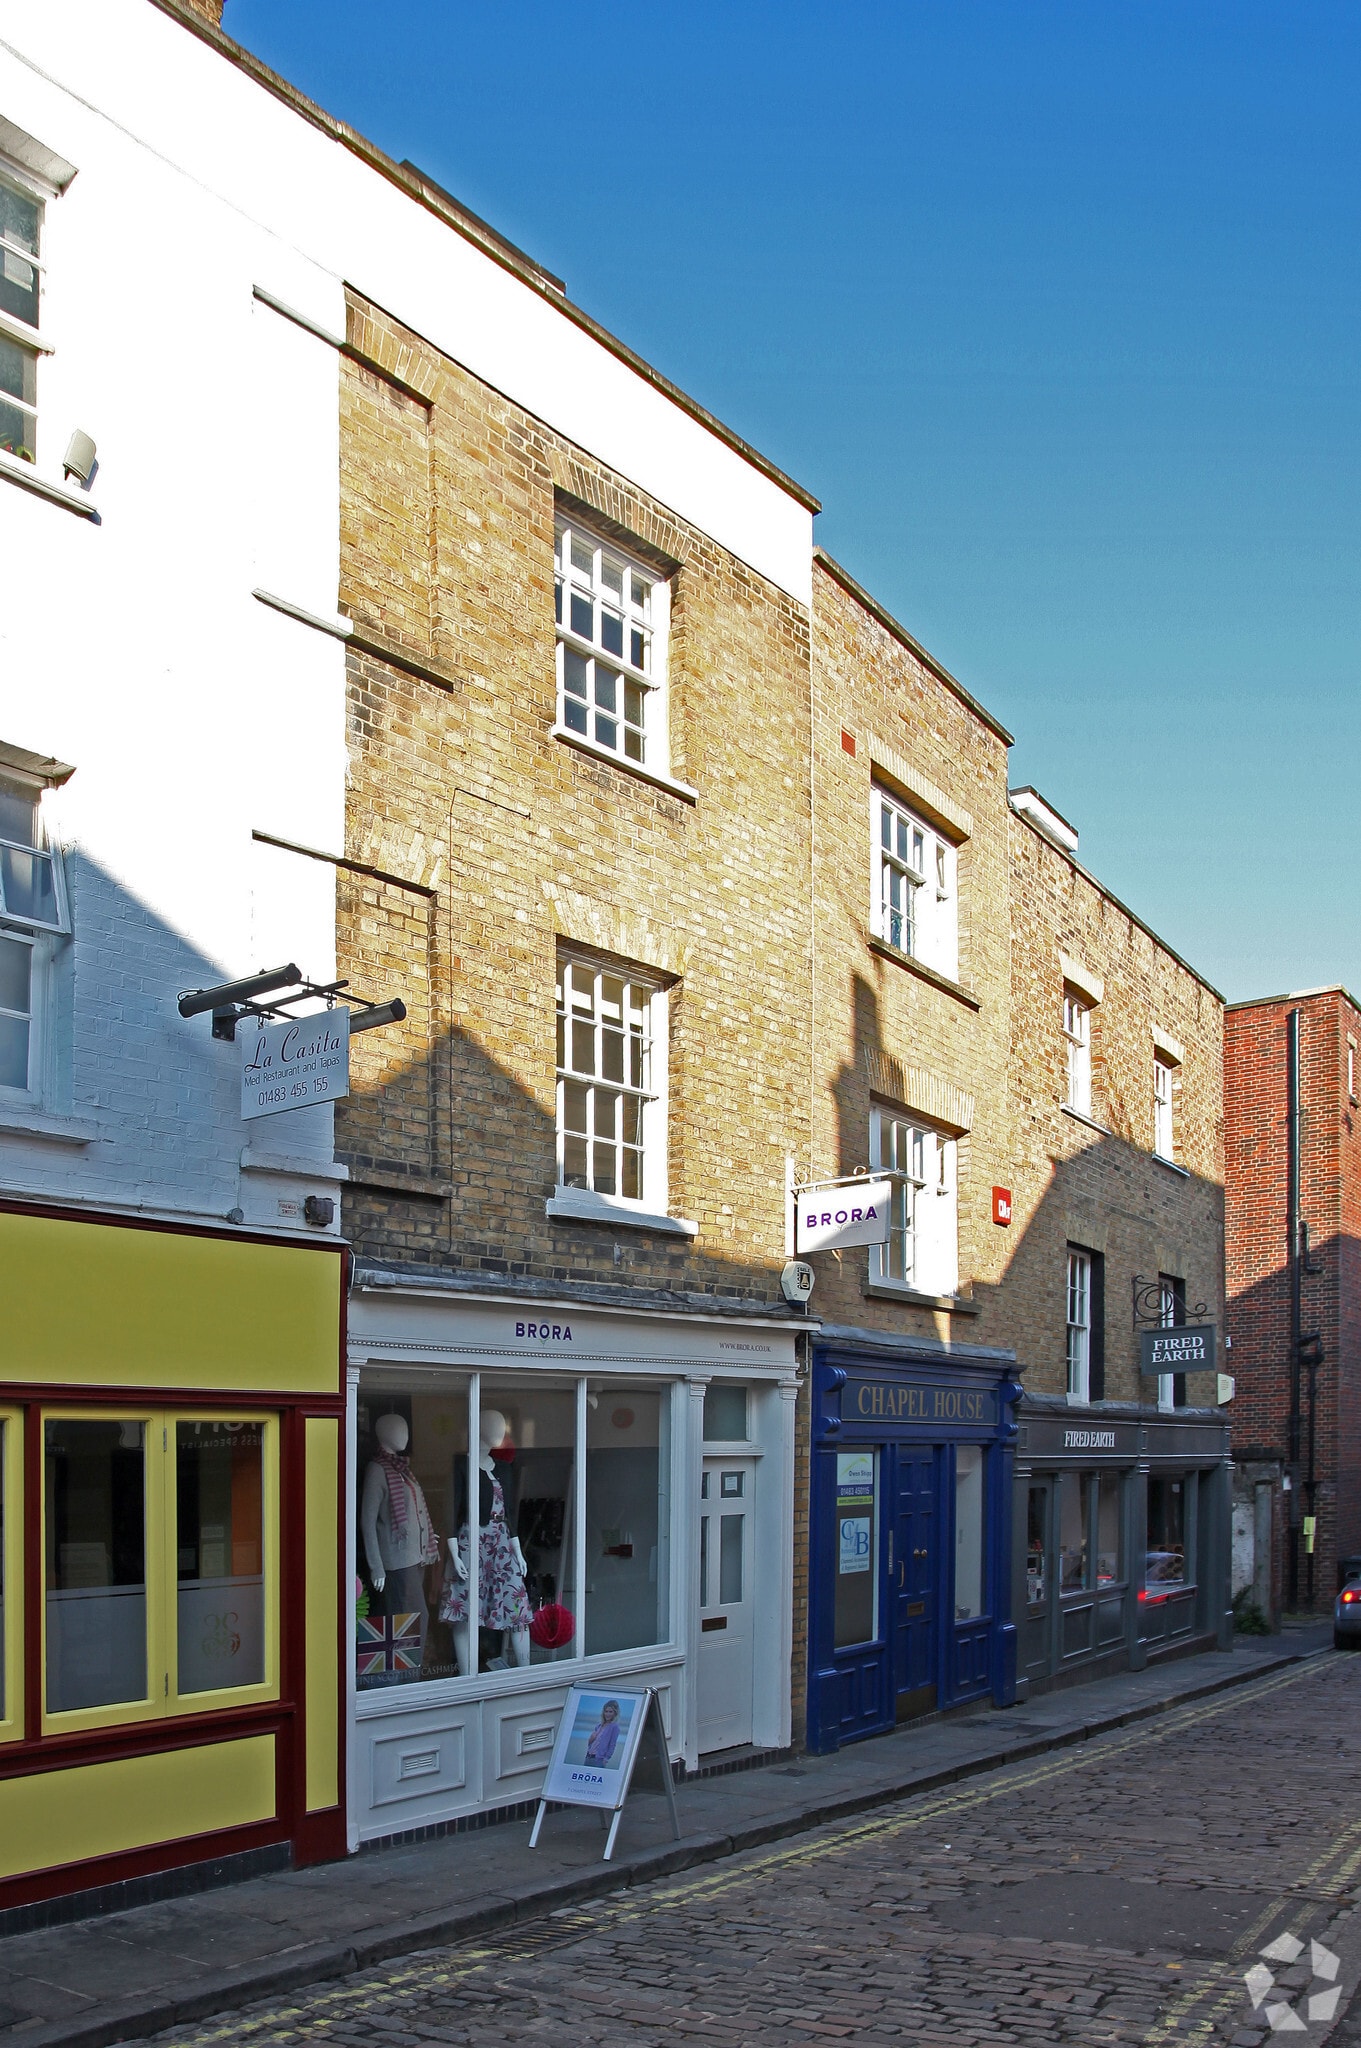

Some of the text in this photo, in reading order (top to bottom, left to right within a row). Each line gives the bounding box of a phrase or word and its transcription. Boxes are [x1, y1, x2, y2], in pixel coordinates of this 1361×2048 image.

[244, 1026, 341, 1073] La Casita
[244, 1055, 340, 1088] Med Restaurant and Tapas
[258, 1076, 329, 1106] 01483 455 155
[806, 1205, 878, 1228] BRORA
[515, 1321, 573, 1341] BRORA
[1152, 1335, 1204, 1352] FIRED
[1151, 1347, 1206, 1364] EARTH
[857, 1385, 984, 1420] CHAPEL HOUSE
[1064, 1430, 1116, 1448] FIRED EARTH
[571, 1772, 603, 1784] BRORA
